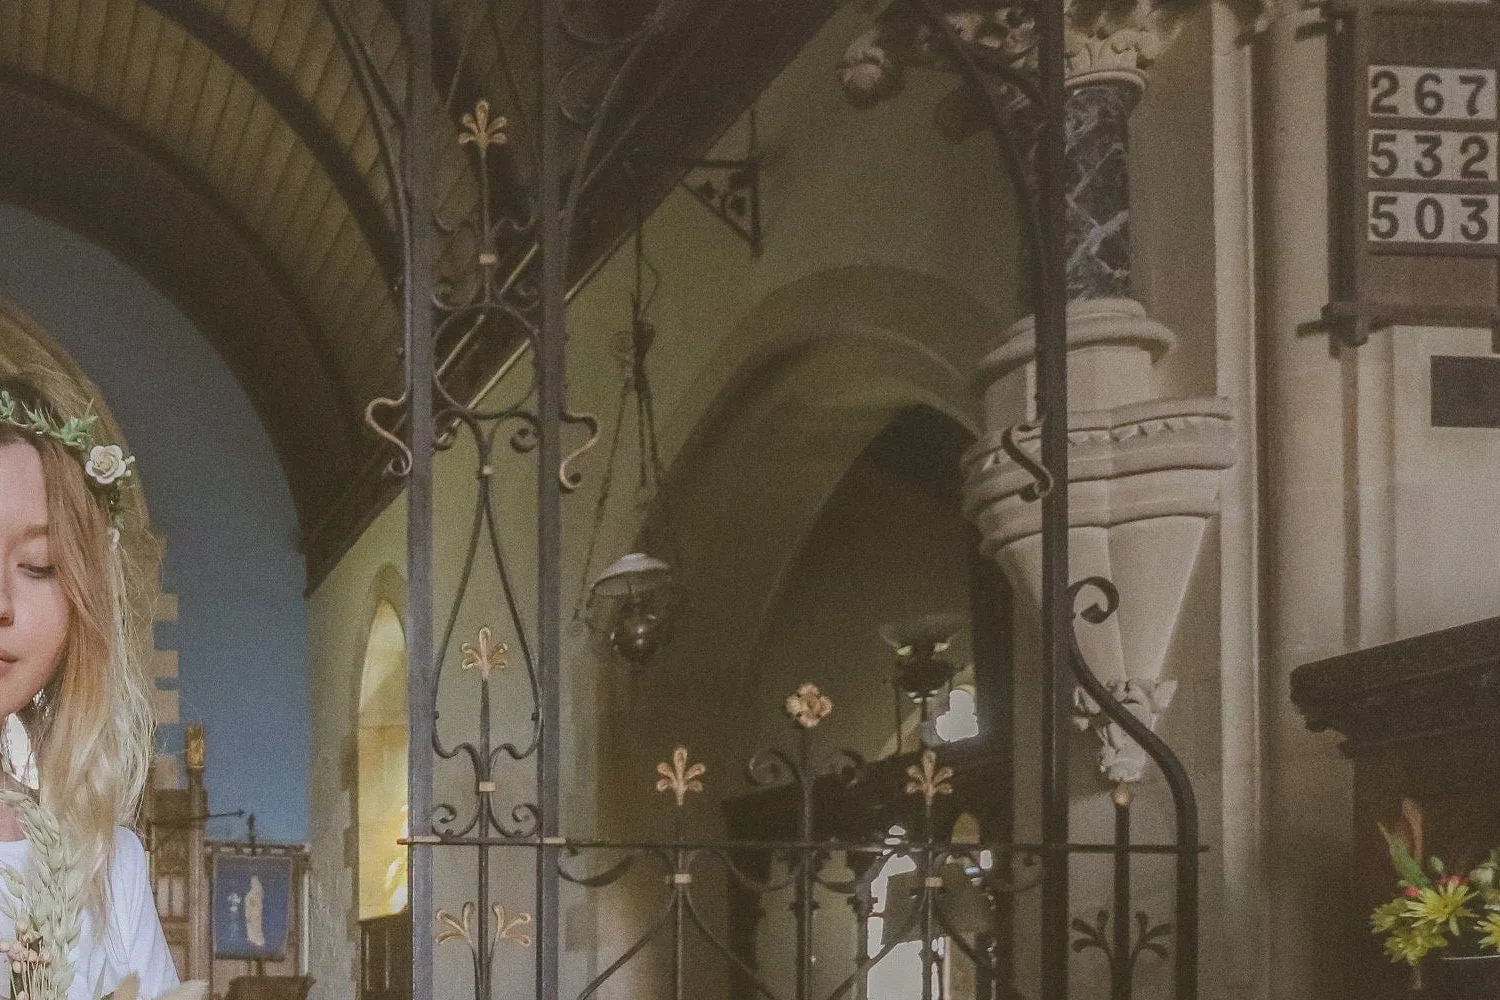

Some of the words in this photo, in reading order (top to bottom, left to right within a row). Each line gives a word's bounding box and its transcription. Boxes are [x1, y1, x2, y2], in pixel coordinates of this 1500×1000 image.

[1370, 70, 1486, 117] 267
[1370, 133, 1489, 180] 532
[1370, 196, 1489, 241] 503
